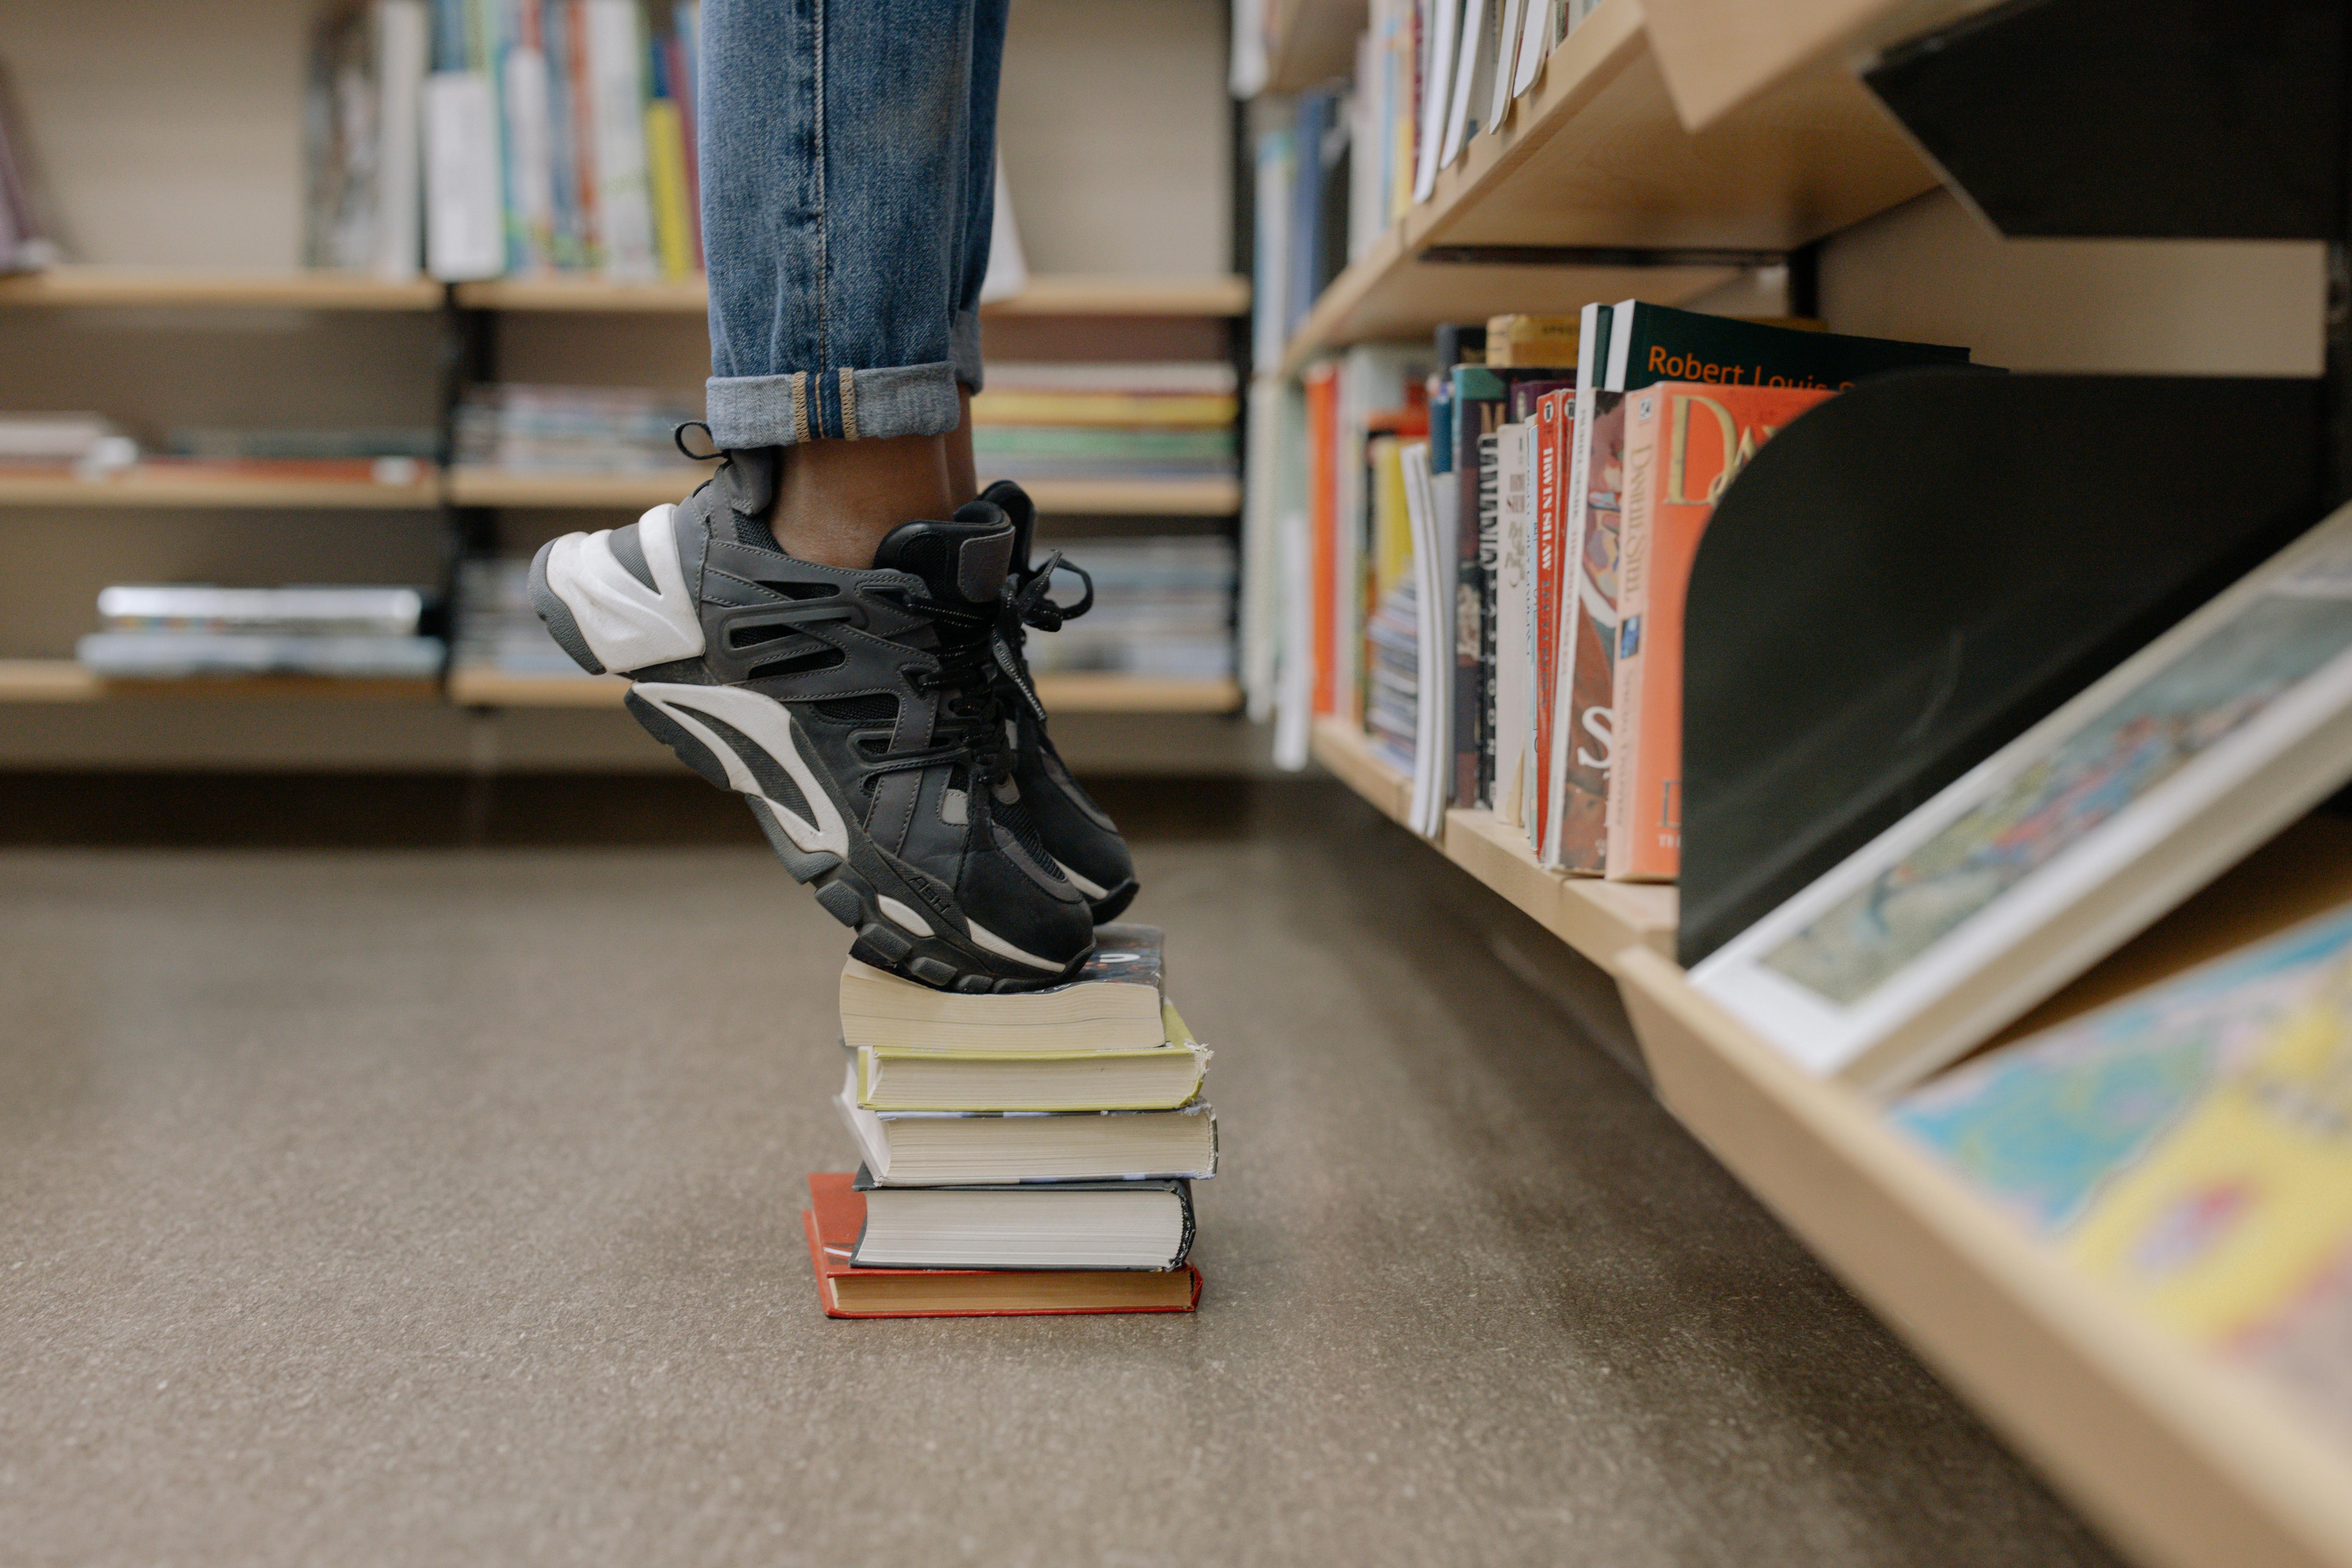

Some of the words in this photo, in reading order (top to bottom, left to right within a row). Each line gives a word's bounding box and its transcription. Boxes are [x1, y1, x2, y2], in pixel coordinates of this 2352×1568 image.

[1648, 345, 1744, 384] Robert
[1542, 447, 1553, 508] IRWIN
[1542, 511, 1553, 570] SHAW
[908, 876, 952, 913] ASH
